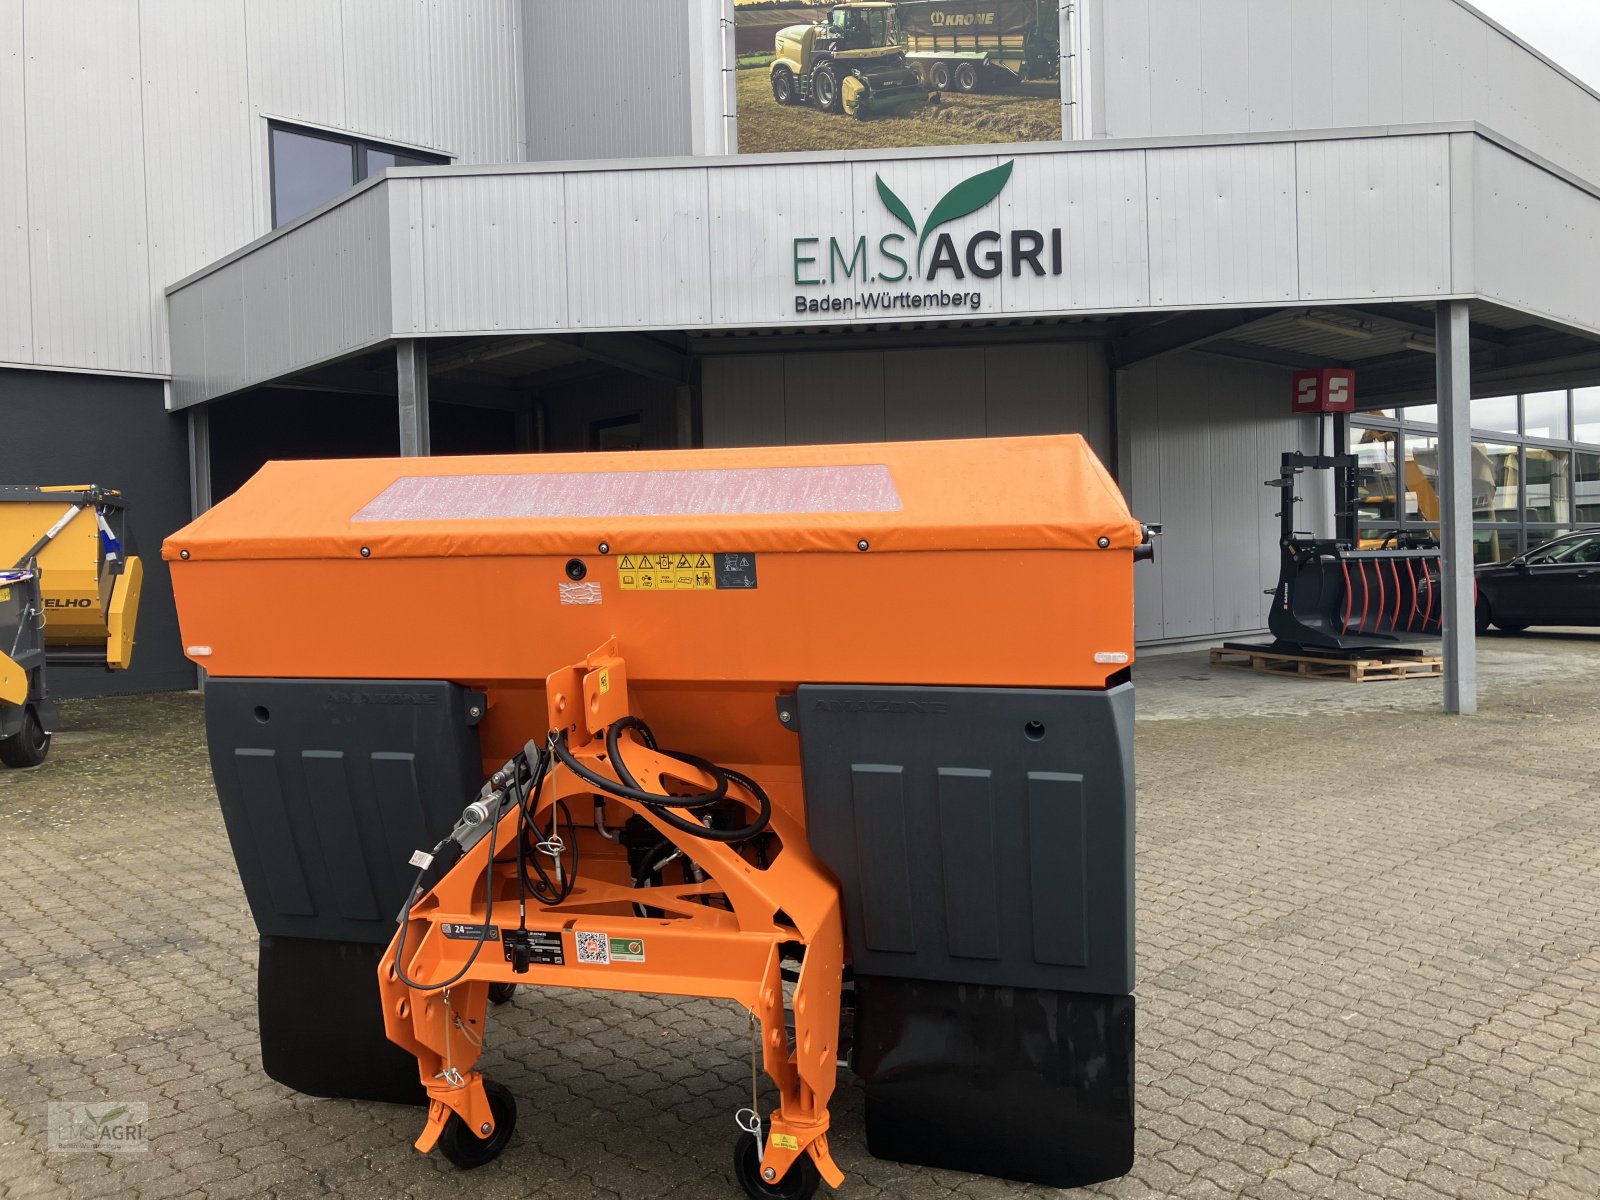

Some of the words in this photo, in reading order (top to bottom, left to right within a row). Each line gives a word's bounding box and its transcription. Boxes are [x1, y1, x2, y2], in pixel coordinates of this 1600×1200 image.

[945, 12, 995, 26] KRONE
[793, 233, 913, 286] E.M.S.
[926, 228, 1063, 281] AGRI
[795, 289, 981, 313] Baden-Württemberg
[44, 598, 92, 608] ELHO
[813, 699, 948, 714] AMAZONE
[454, 925, 465, 934] 24
